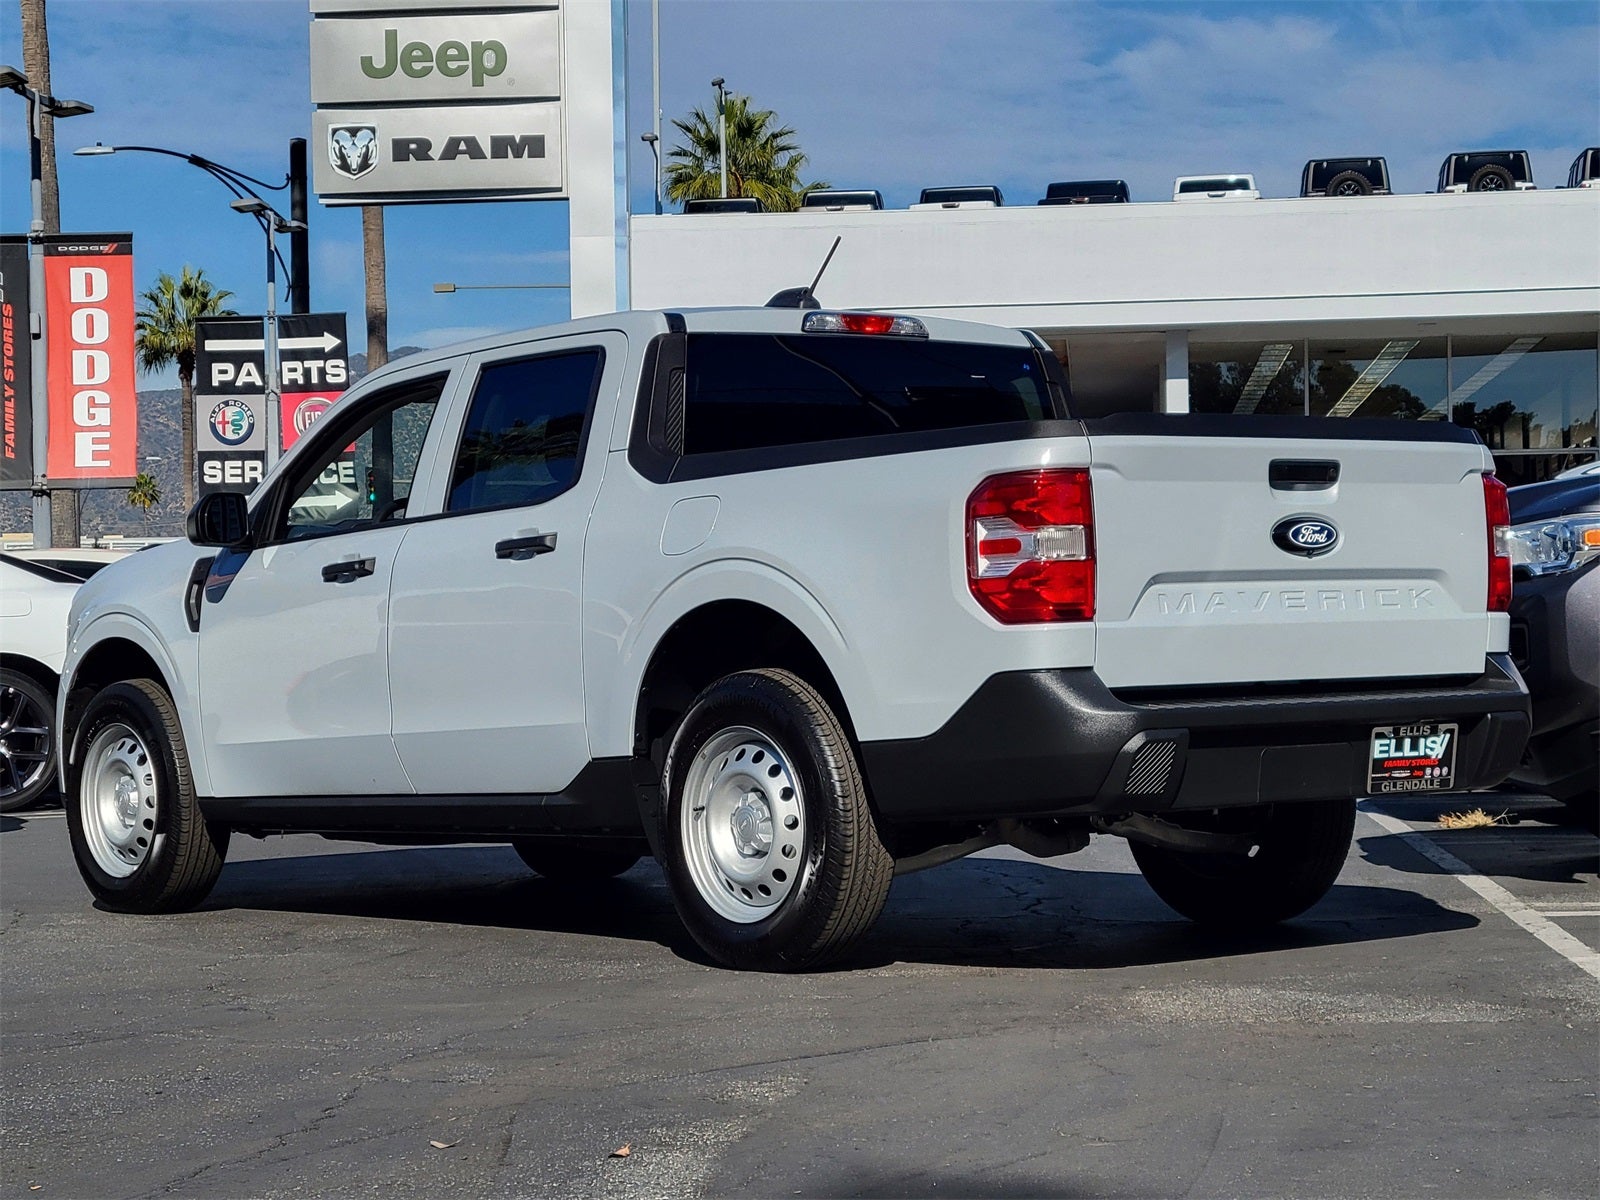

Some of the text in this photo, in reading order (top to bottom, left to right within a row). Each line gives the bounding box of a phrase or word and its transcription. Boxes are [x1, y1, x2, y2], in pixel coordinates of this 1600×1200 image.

[360, 29, 508, 87] Jeep
[391, 134, 546, 163] RAM
[69, 266, 112, 468] DODGE
[2, 303, 16, 459] FAMILY STORES
[210, 400, 254, 424] ALFA ROMEO
[1299, 525, 1328, 543] Ford
[1156, 588, 1436, 616] MAVERICK
[1399, 725, 1431, 737] ELLIS
[1373, 735, 1441, 759] ELLIS
[1383, 757, 1439, 768] FAMILY STORES
[1381, 780, 1441, 792] GLENDALE
